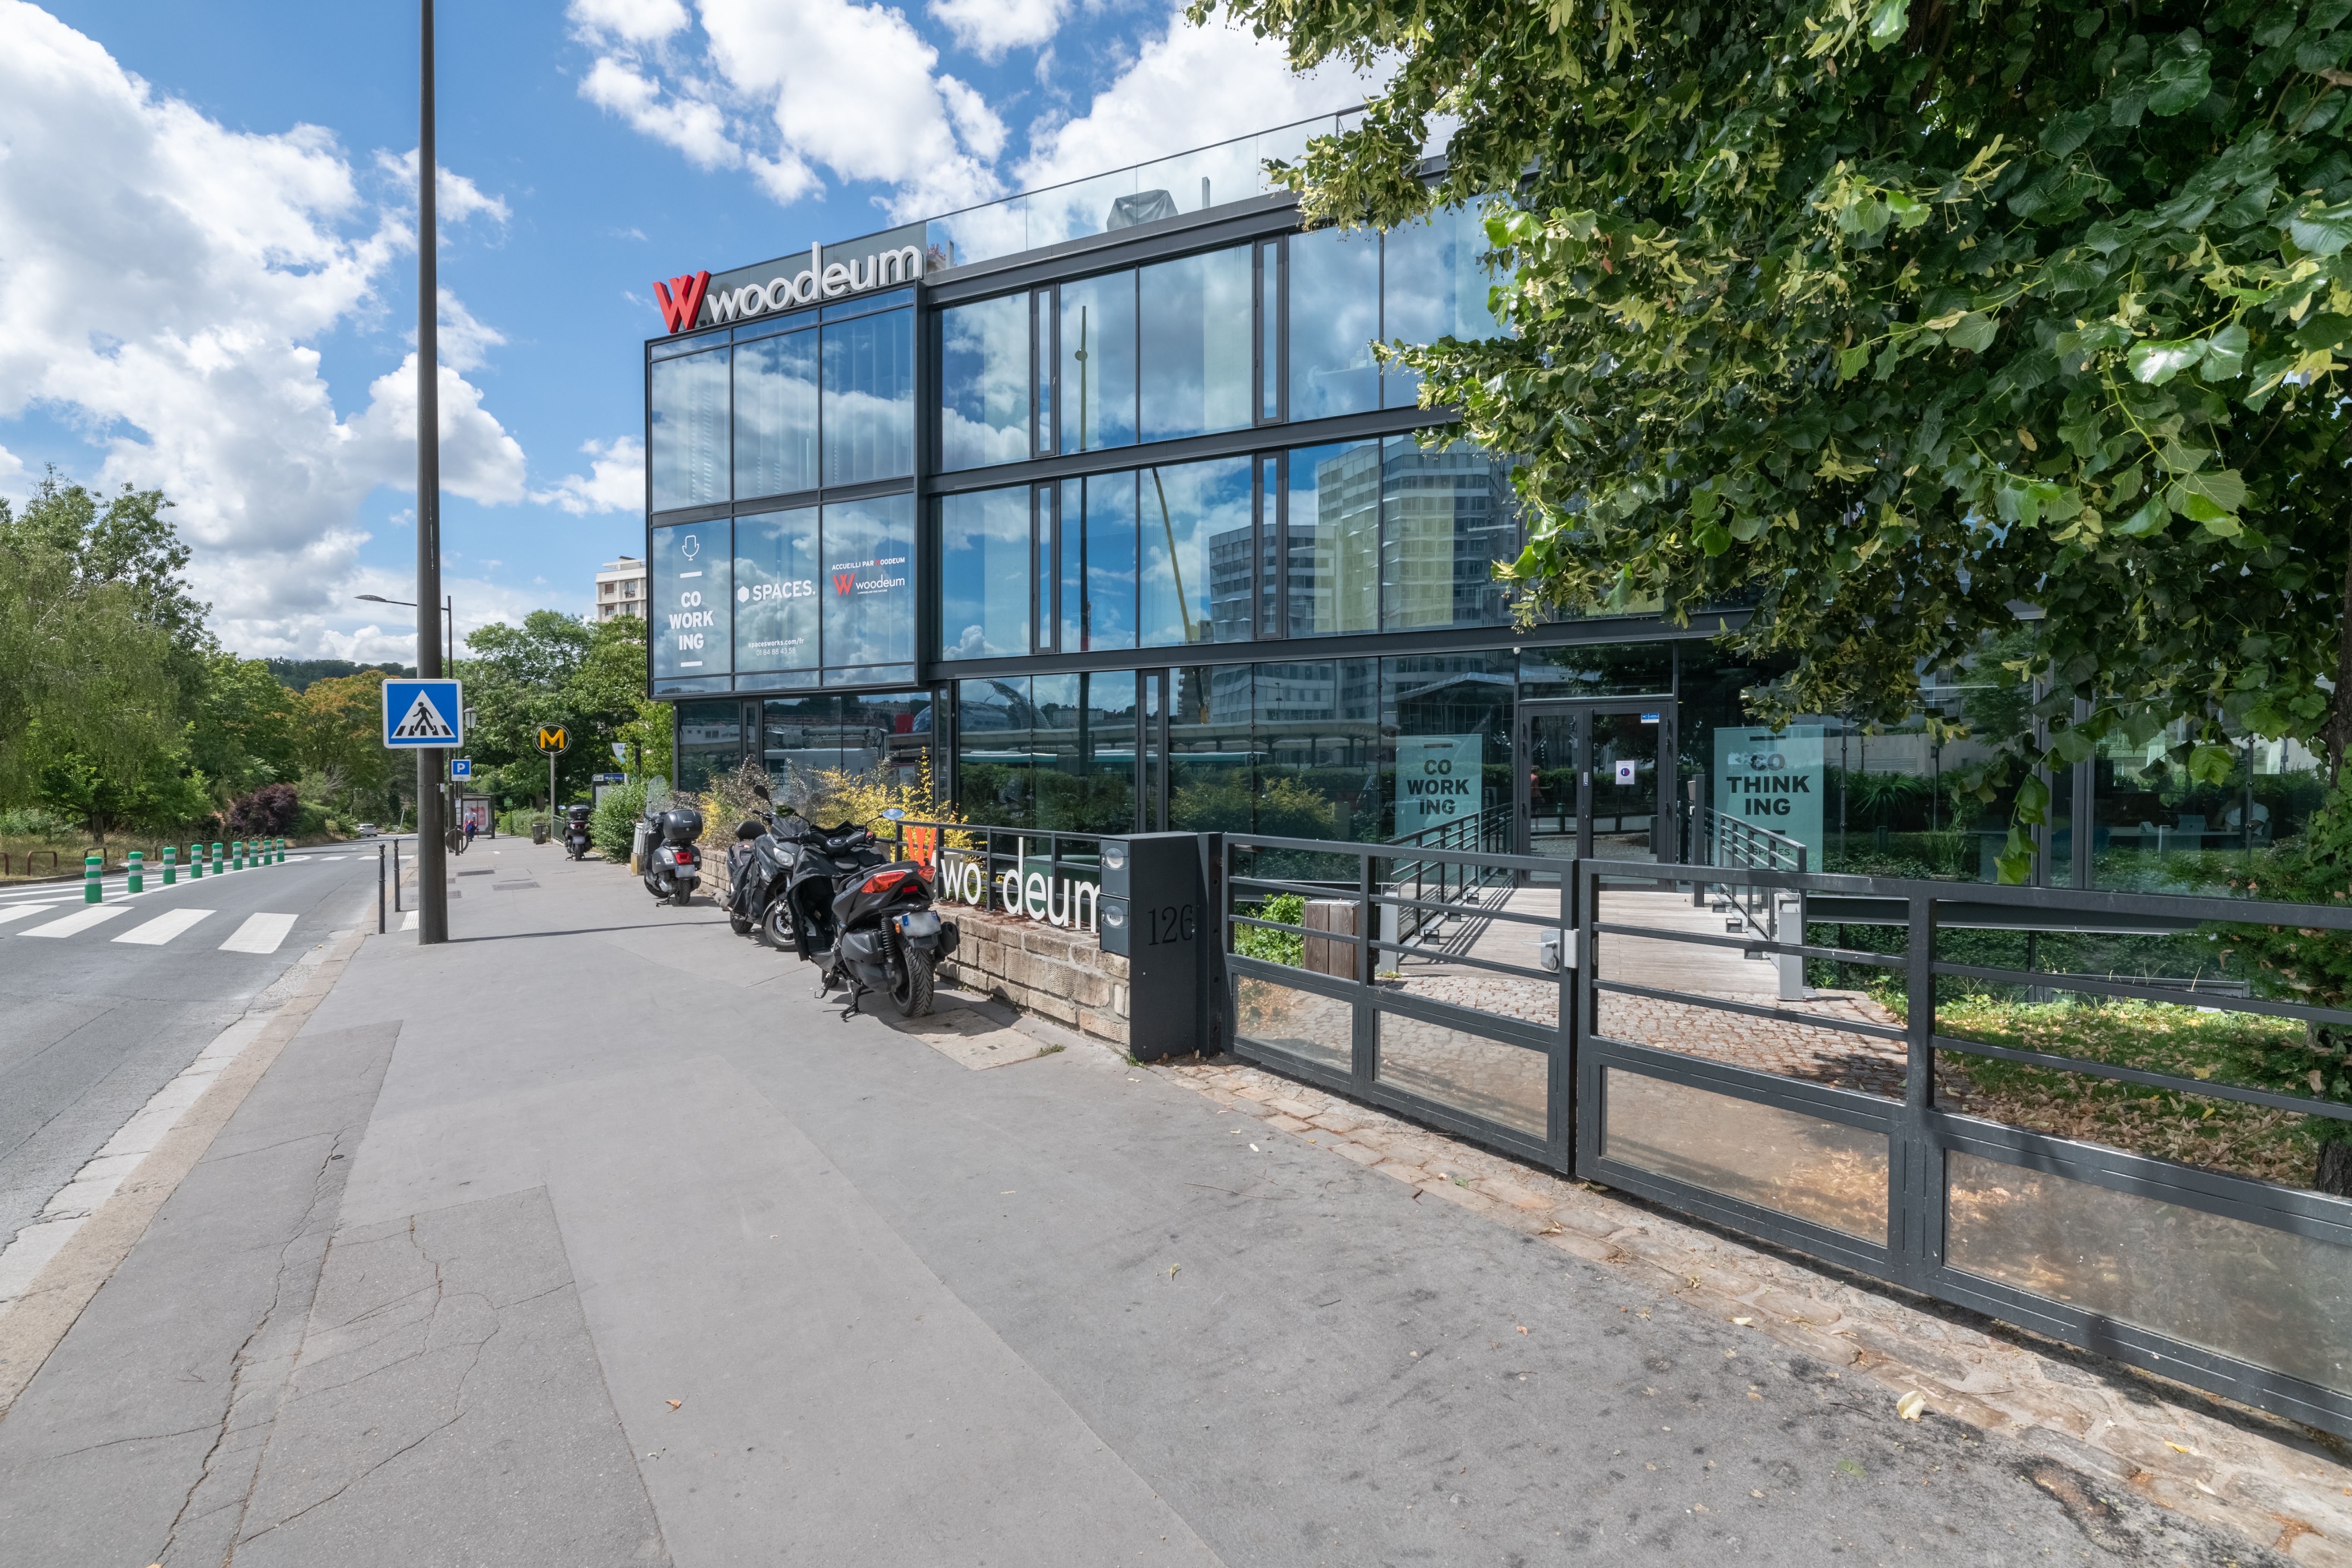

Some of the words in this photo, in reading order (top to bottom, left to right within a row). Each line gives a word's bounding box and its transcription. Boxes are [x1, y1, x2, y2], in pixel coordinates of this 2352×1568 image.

[707, 241, 923, 323] woodeum
[832, 562, 861, 570] ACCUEILLI
[752, 580, 816, 601] SPACES.
[855, 574, 905, 590] woodeum
[681, 591, 701, 607] CO
[669, 610, 714, 629] WORK
[678, 633, 704, 650] ING
[748, 637, 804, 648] spacesworks.com/fr
[540, 729, 564, 749] M
[457, 763, 465, 773] P
[1424, 759, 1452, 775] CO
[1750, 753, 1785, 771] CO
[1407, 779, 1470, 795] WORK
[1726, 775, 1810, 793] THINK
[1419, 799, 1456, 815] ING
[1745, 798, 1791, 816] ING
[1148, 904, 1192, 945] 126
